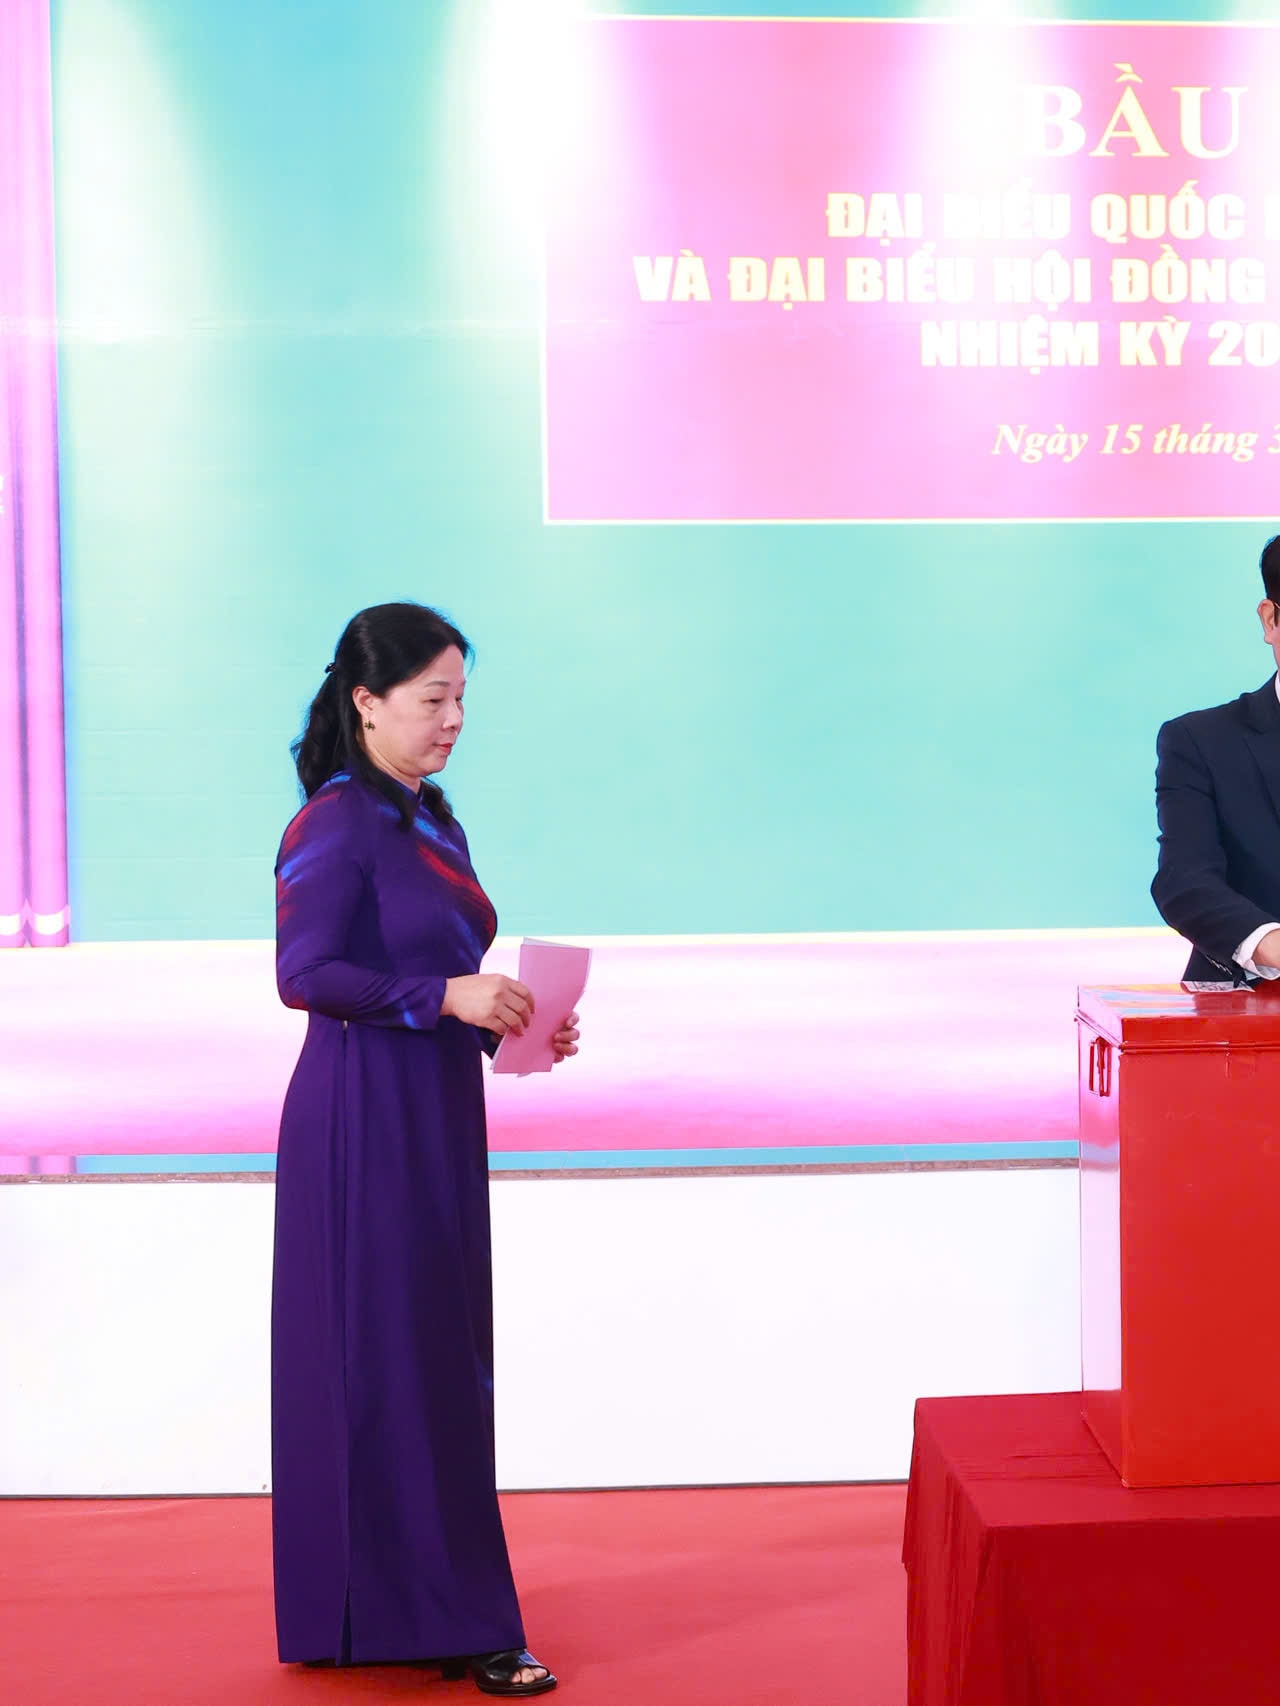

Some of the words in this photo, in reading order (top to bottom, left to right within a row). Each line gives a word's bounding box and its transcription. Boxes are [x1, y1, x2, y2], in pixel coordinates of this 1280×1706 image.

[1016, 62, 1248, 160] BẦU
[825, 192, 924, 246] ĐẠI
[1091, 180, 1245, 243] QUỐC
[632, 249, 712, 302] VÀ
[727, 255, 825, 310] ĐẠI
[845, 242, 975, 303] BIỂU
[993, 250, 1092, 311] HỘI
[1110, 244, 1266, 304] ĐỒNG
[920, 314, 1100, 376] NHIỆM
[1119, 314, 1192, 367] KỲ
[991, 423, 1089, 464] Ngày
[1099, 423, 1144, 455] 15
[1152, 422, 1259, 463] tháng
